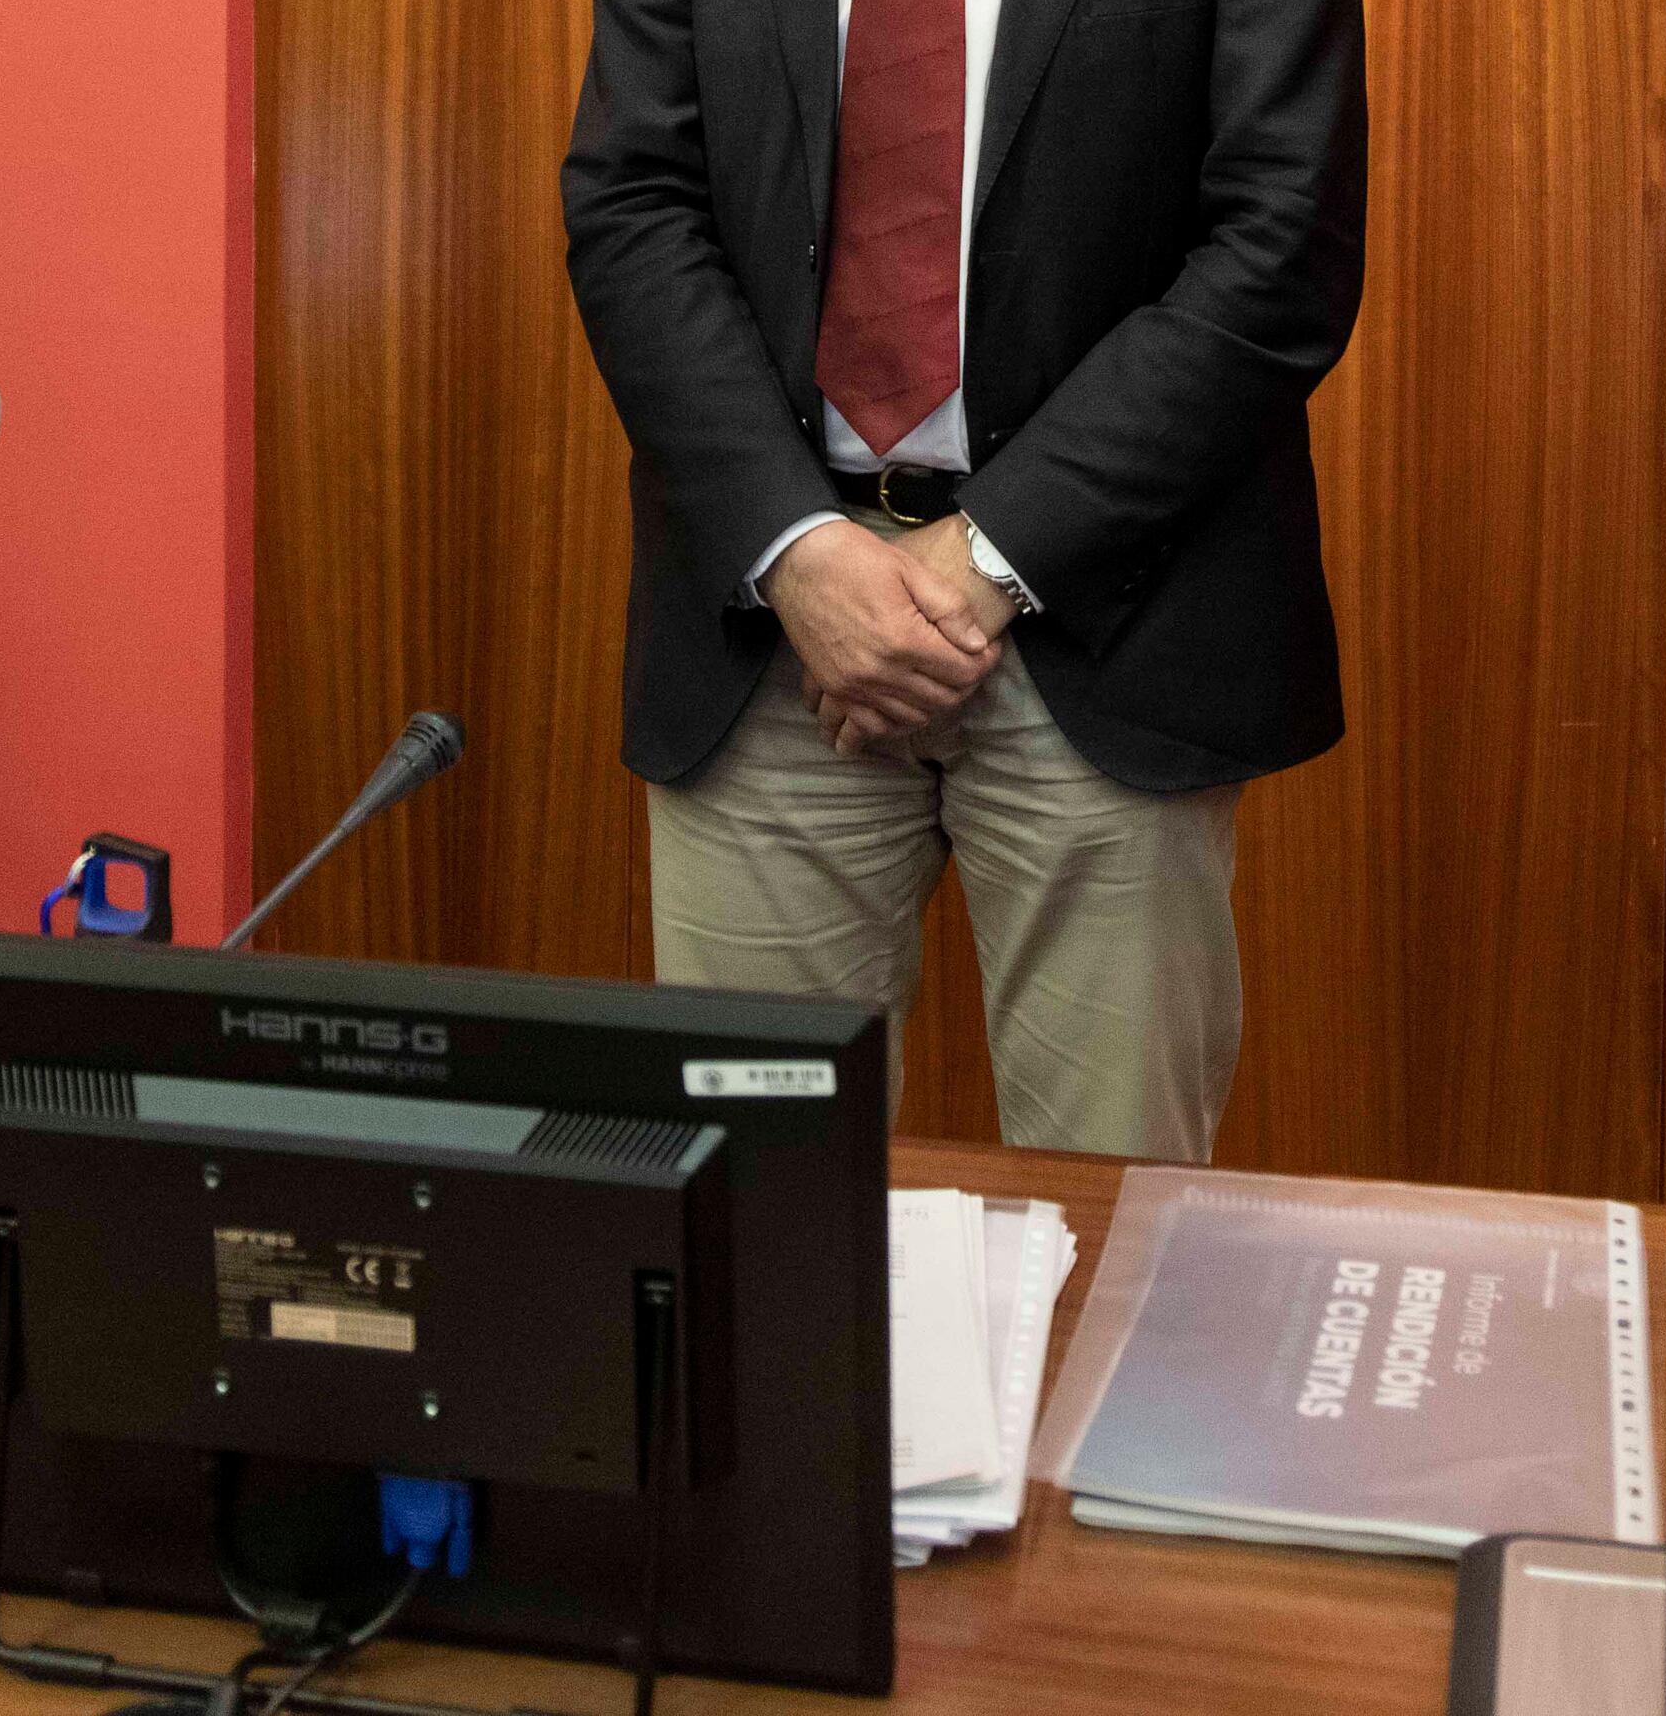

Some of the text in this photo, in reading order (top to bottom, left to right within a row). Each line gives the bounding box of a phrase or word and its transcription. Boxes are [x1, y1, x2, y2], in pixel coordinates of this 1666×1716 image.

[1296, 1260, 1380, 1419] DE CUENTAS
[1373, 1266, 1446, 1409] RENDICIÓN
[1452, 1274, 1504, 1374] Informe de
